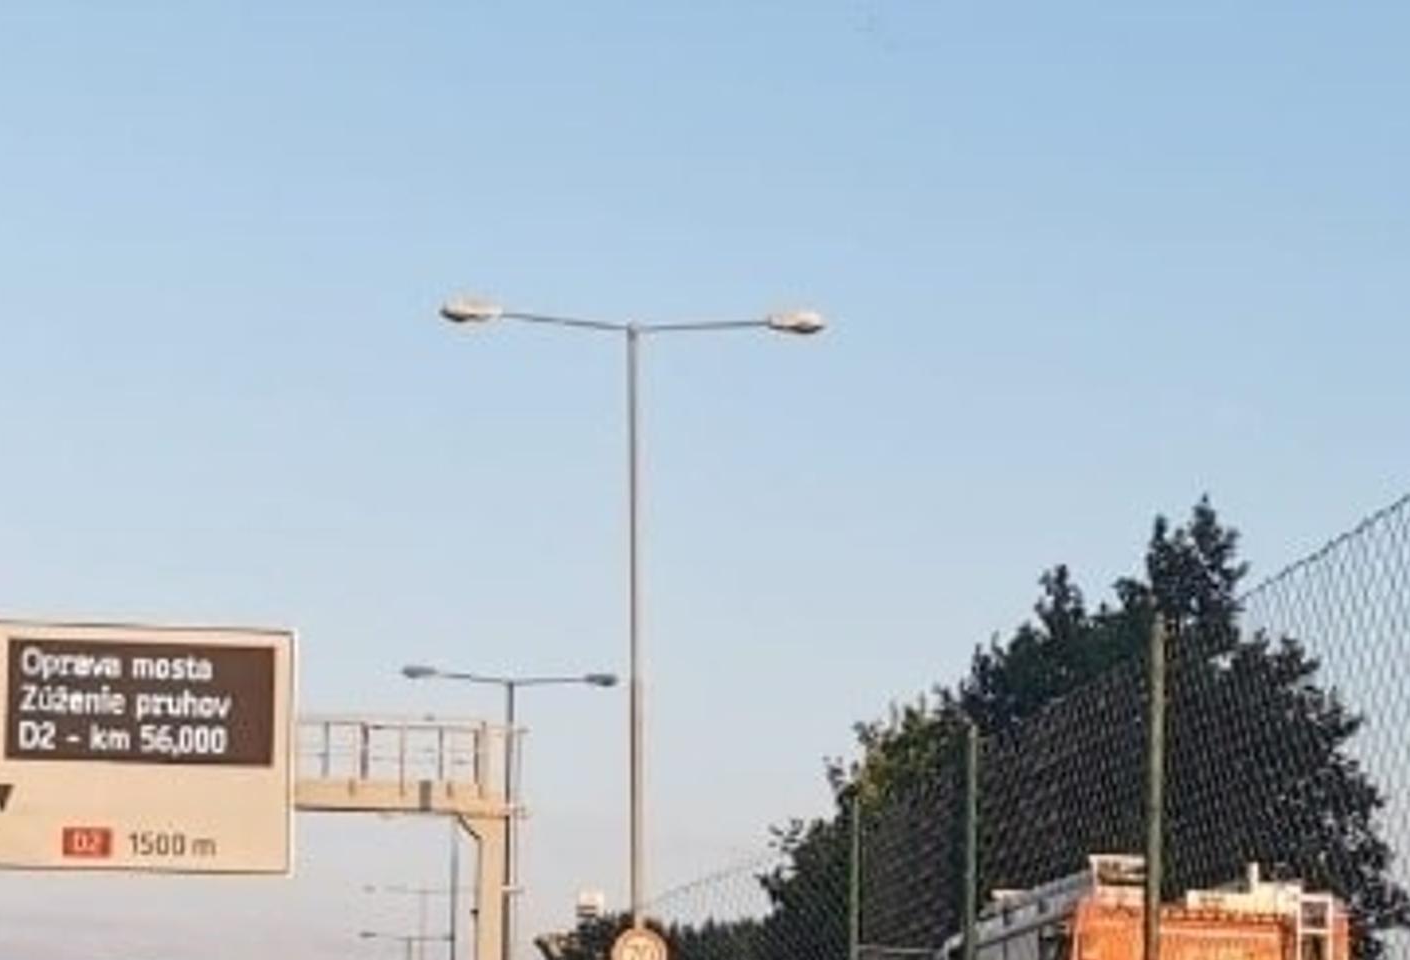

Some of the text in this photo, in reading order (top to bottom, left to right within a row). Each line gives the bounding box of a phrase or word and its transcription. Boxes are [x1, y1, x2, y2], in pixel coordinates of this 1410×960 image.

[21, 646, 213, 681] Oprava mosta
[19, 685, 232, 720] Zúženie pruhov
[18, 721, 56, 750] D2
[89, 724, 130, 750] km
[140, 724, 228, 757] 56,000
[73, 830, 217, 857] D2 1500 m
